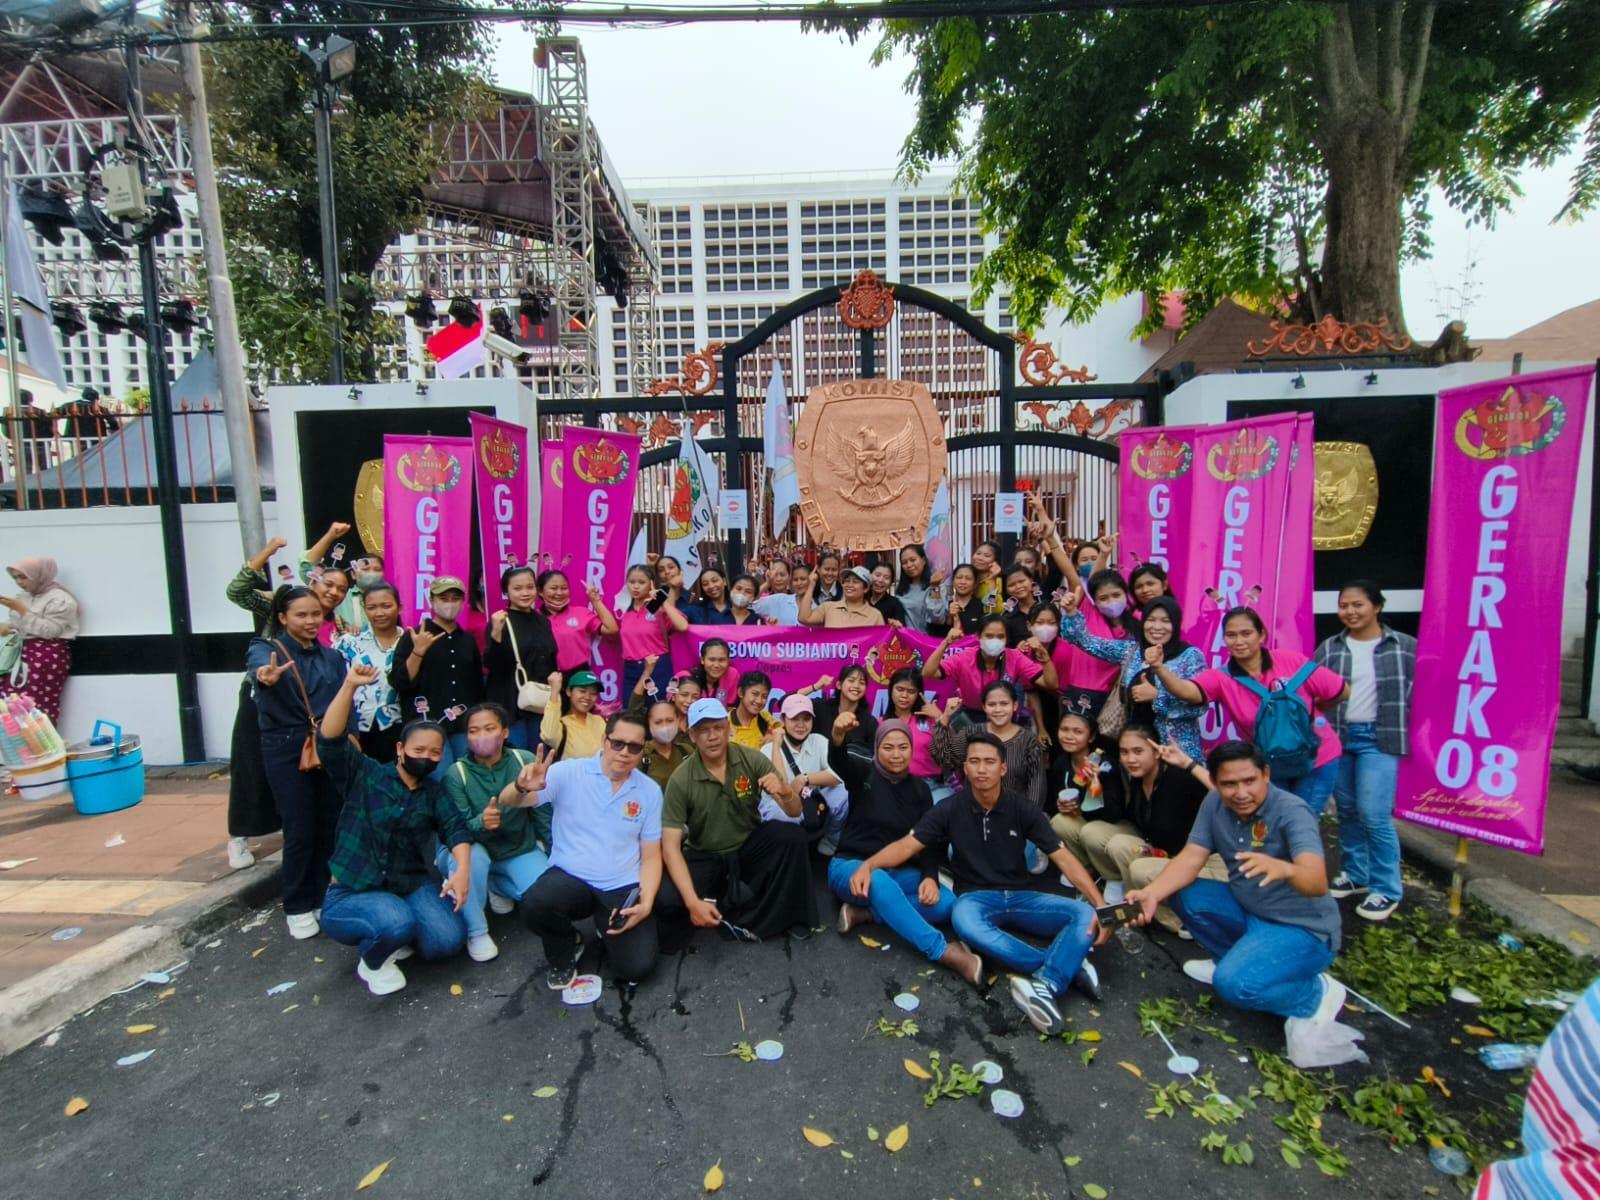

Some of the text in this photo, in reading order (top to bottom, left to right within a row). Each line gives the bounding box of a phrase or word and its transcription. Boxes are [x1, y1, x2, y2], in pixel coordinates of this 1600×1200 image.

[824, 381, 916, 401] KOMISI
[1452, 464, 1519, 739] GERAK
[776, 642, 848, 659] SUBIANTO
[600, 668, 619, 702] 8
[1435, 738, 1519, 798] 08
